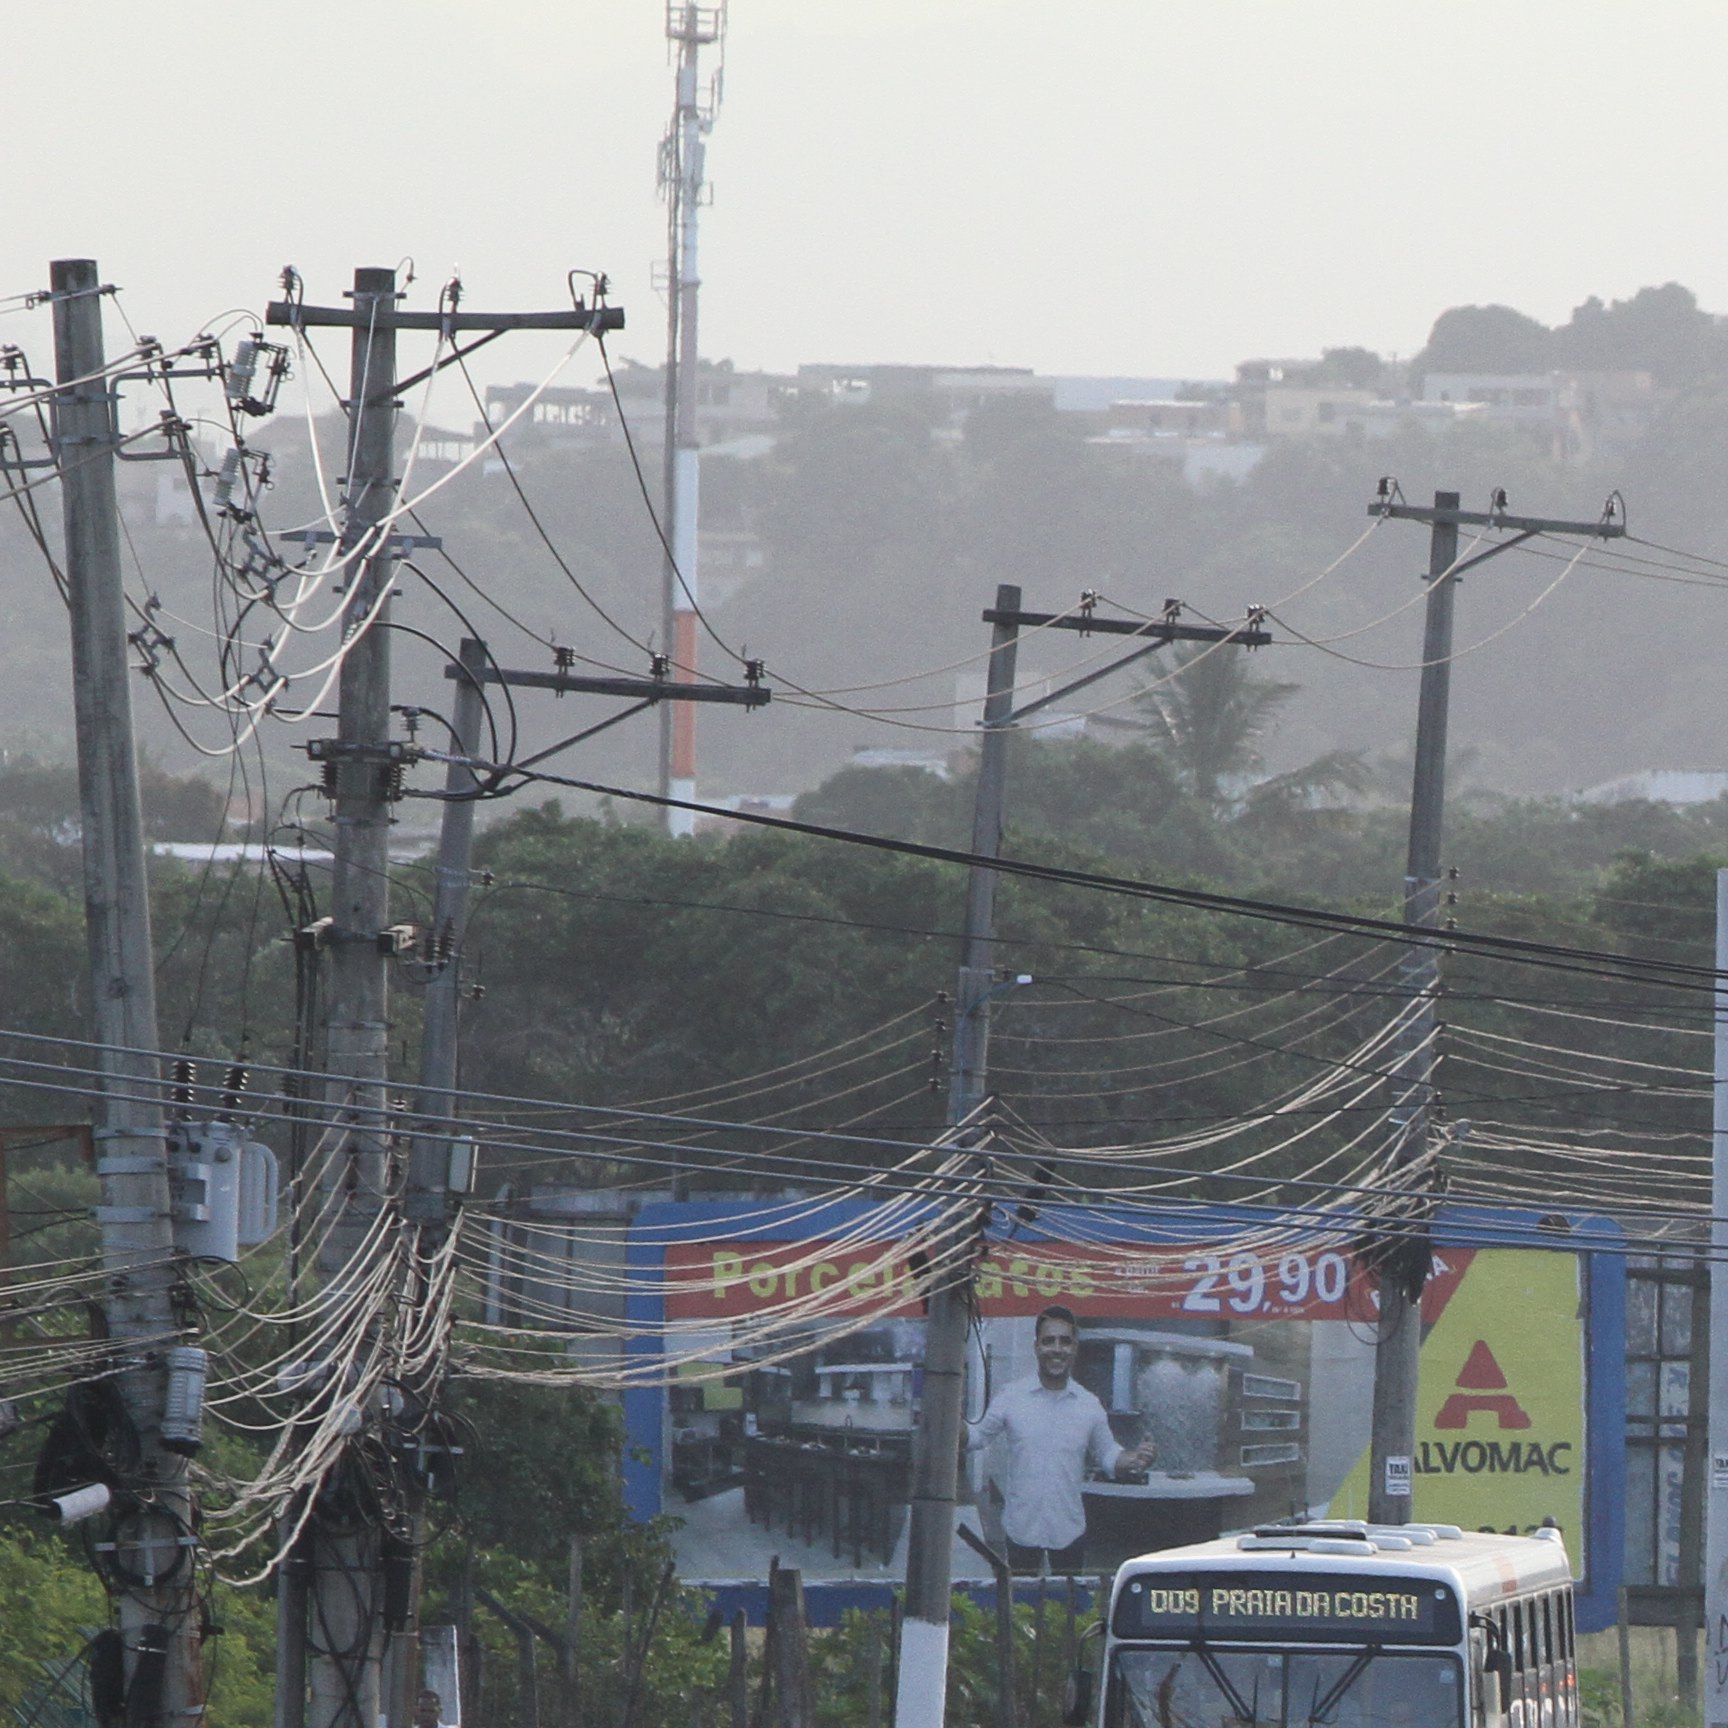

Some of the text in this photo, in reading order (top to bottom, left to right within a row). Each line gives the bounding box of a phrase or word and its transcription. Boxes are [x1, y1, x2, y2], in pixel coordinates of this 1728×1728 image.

[712, 1251, 1096, 1300] Porcelatos
[1182, 1250, 1347, 1318] 29,90
[1212, 1588, 1292, 1617] PRAIA
[1295, 1590, 1331, 1618] DA
[1334, 1592, 1418, 1620] COSTA
